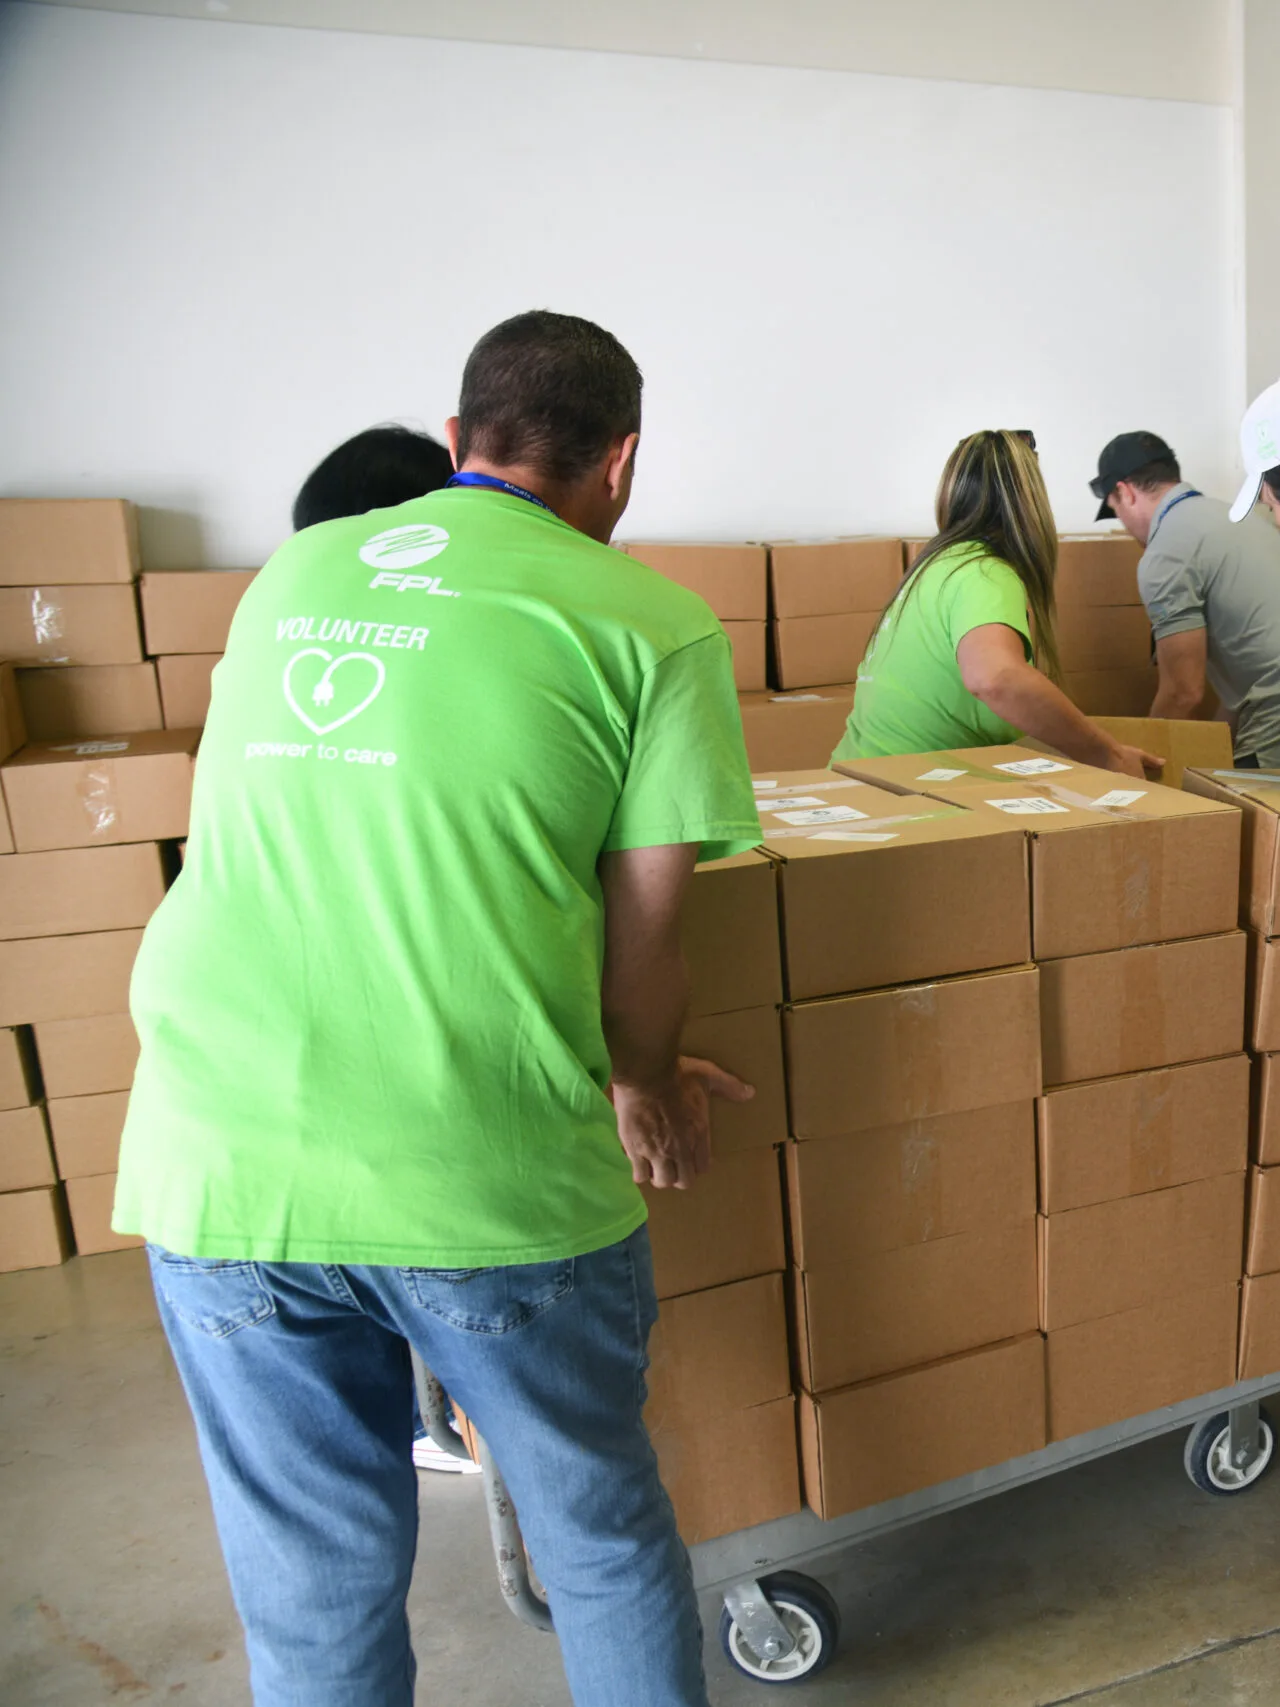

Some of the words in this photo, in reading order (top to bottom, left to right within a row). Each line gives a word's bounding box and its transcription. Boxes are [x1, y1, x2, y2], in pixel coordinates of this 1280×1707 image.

[369, 571, 454, 597] FPL
[275, 616, 430, 651] VOLUNTEER
[245, 741, 313, 761] power
[317, 743, 339, 760] to
[344, 748, 398, 767] care
